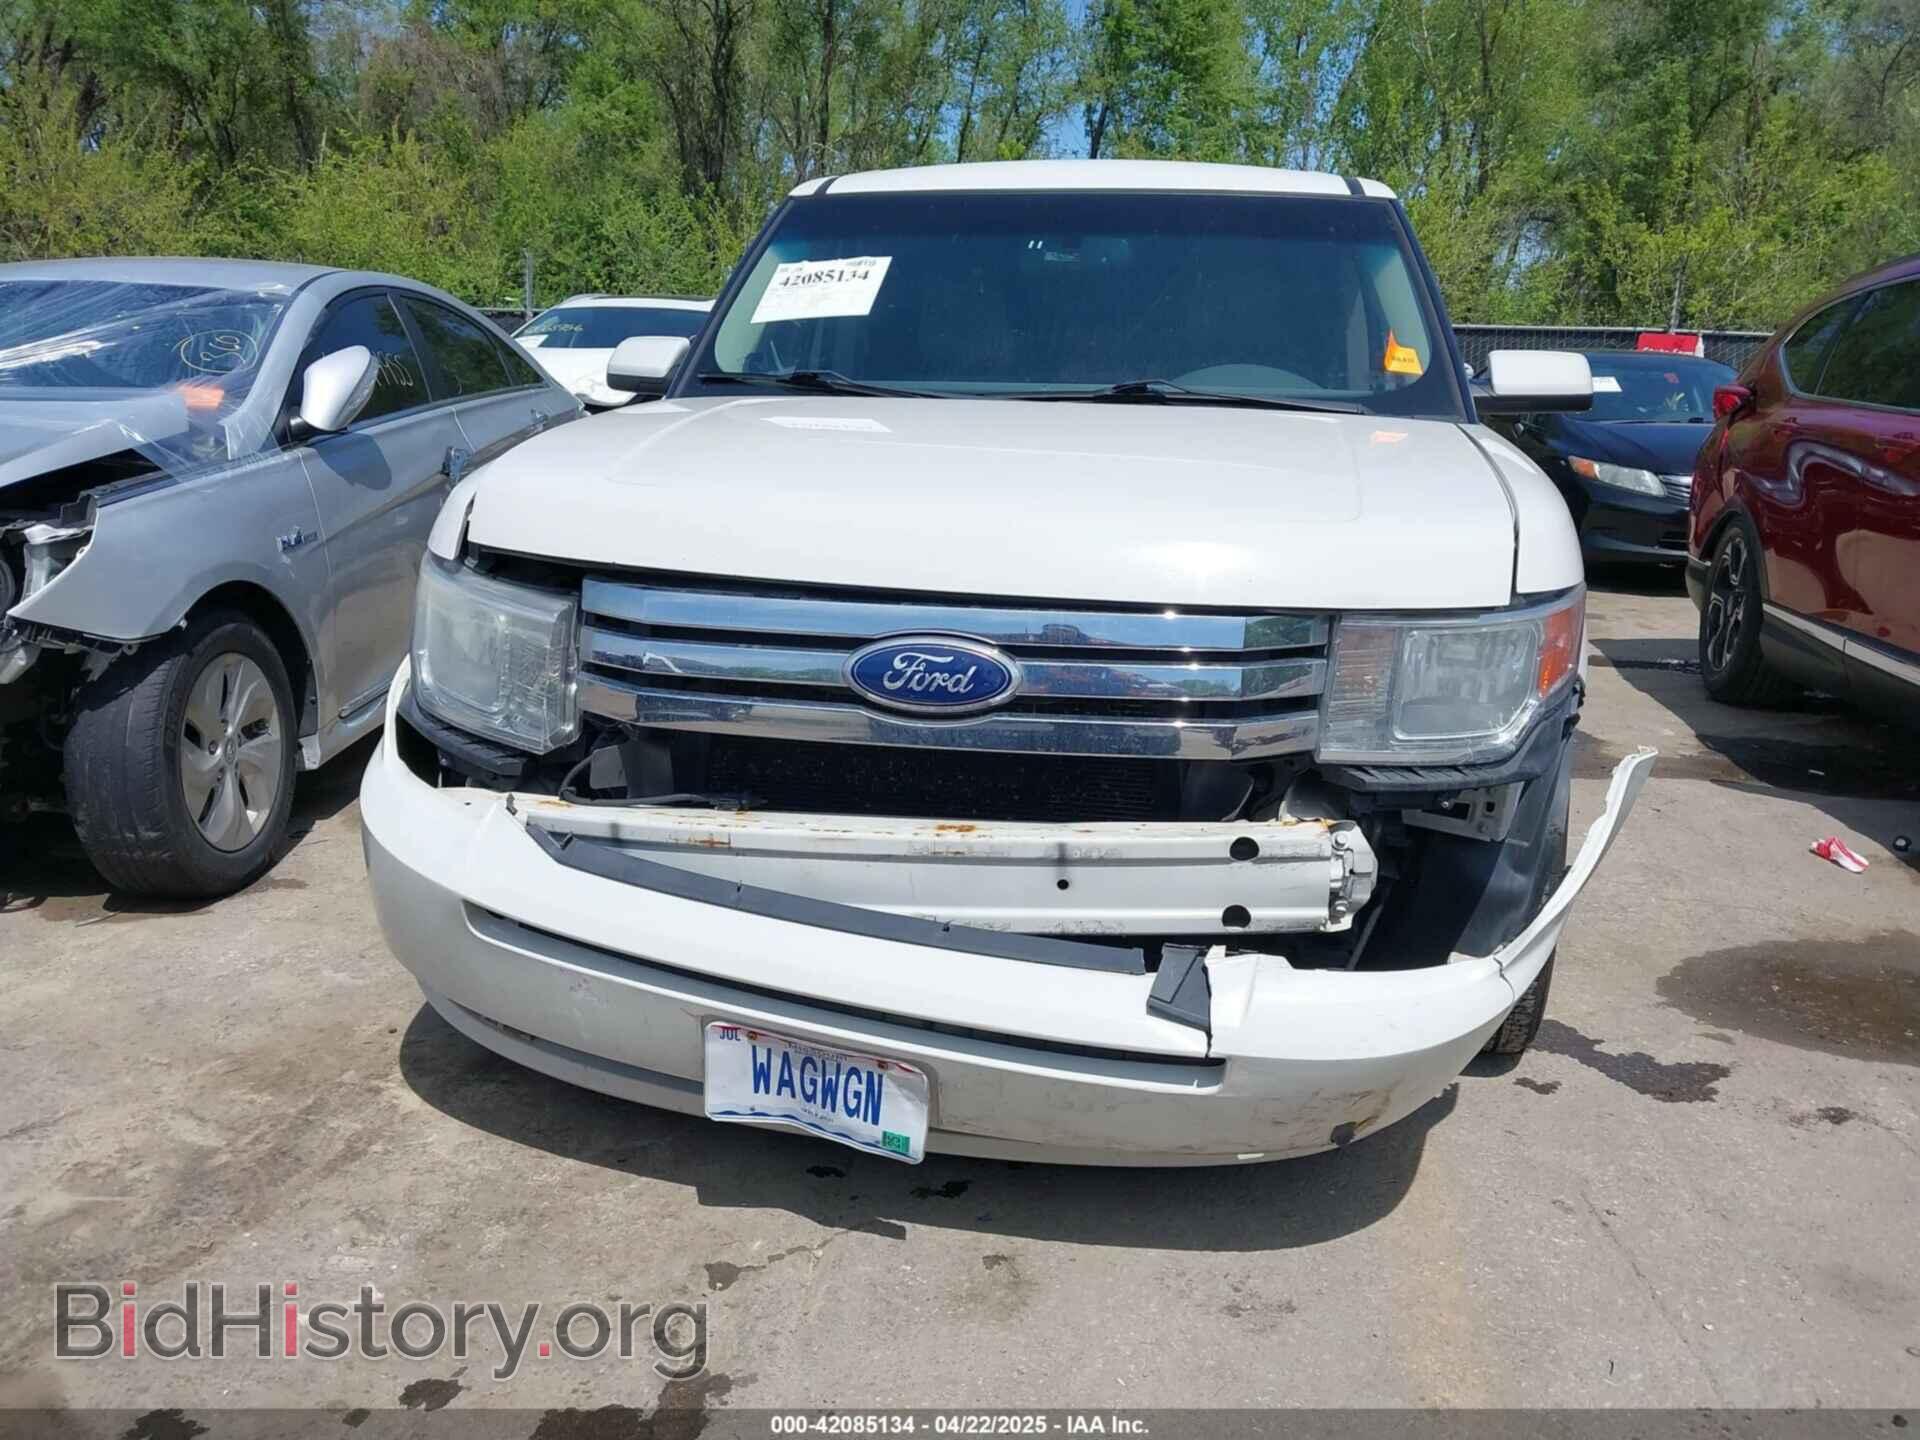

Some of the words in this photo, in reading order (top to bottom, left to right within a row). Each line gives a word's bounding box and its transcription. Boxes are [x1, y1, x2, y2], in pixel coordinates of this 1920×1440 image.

[778, 269, 870, 287] 42085134
[883, 652, 977, 694] Ford
[751, 1045, 884, 1126] WAGWGN
